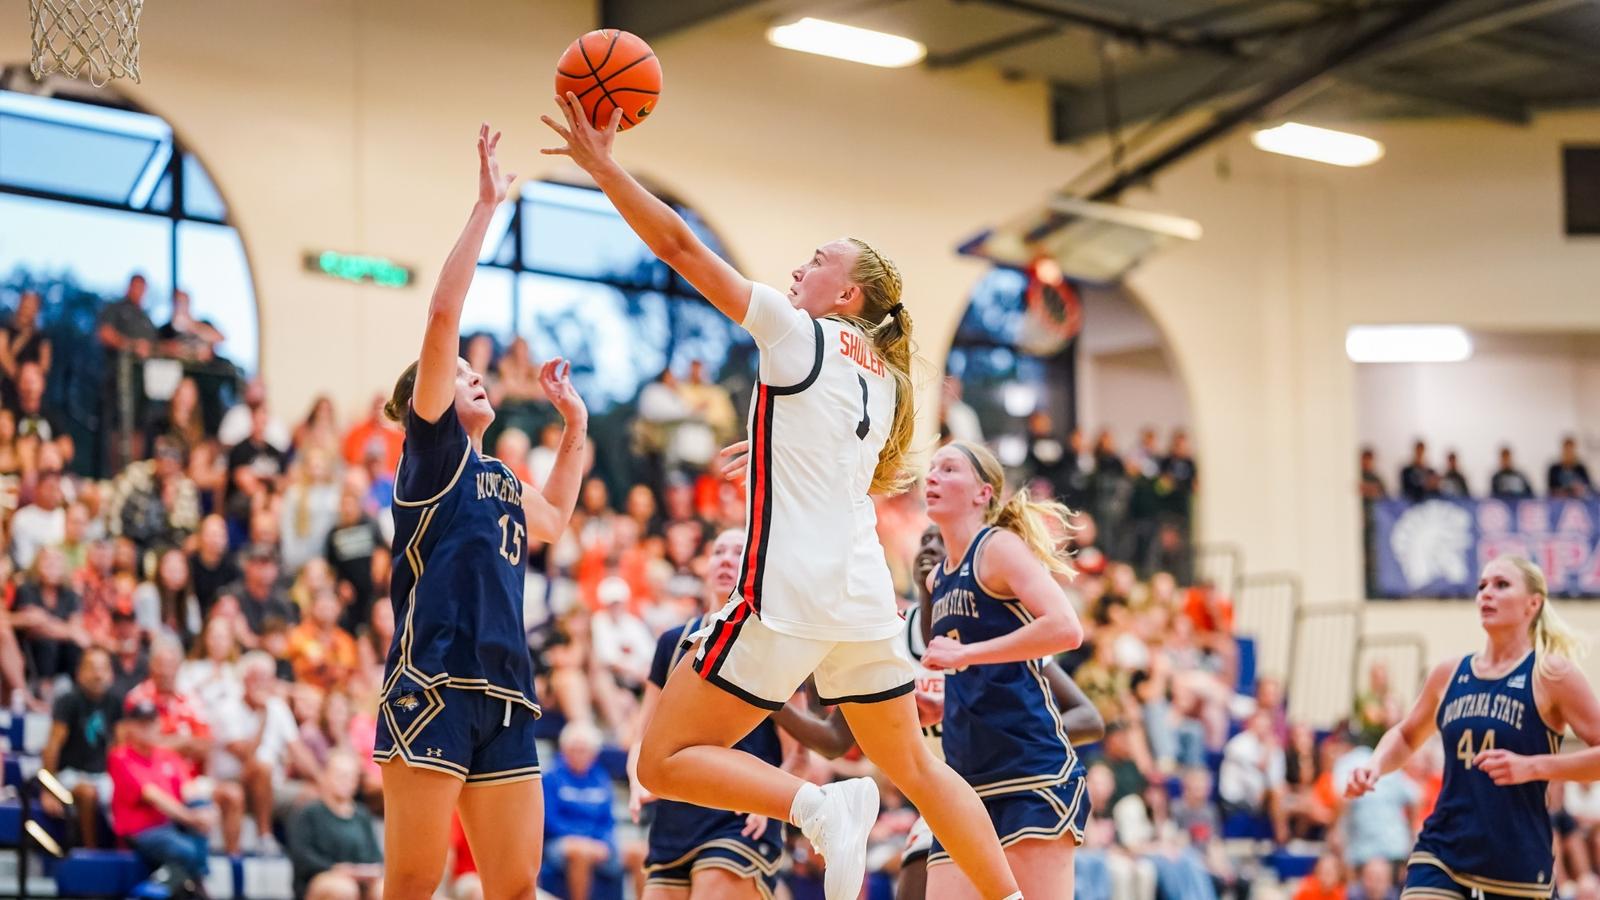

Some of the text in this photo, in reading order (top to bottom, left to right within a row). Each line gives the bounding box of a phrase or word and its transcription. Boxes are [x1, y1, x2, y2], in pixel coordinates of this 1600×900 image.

[855, 372, 871, 441] 1
[498, 513, 525, 566] 15
[1490, 693, 1526, 730] STATE
